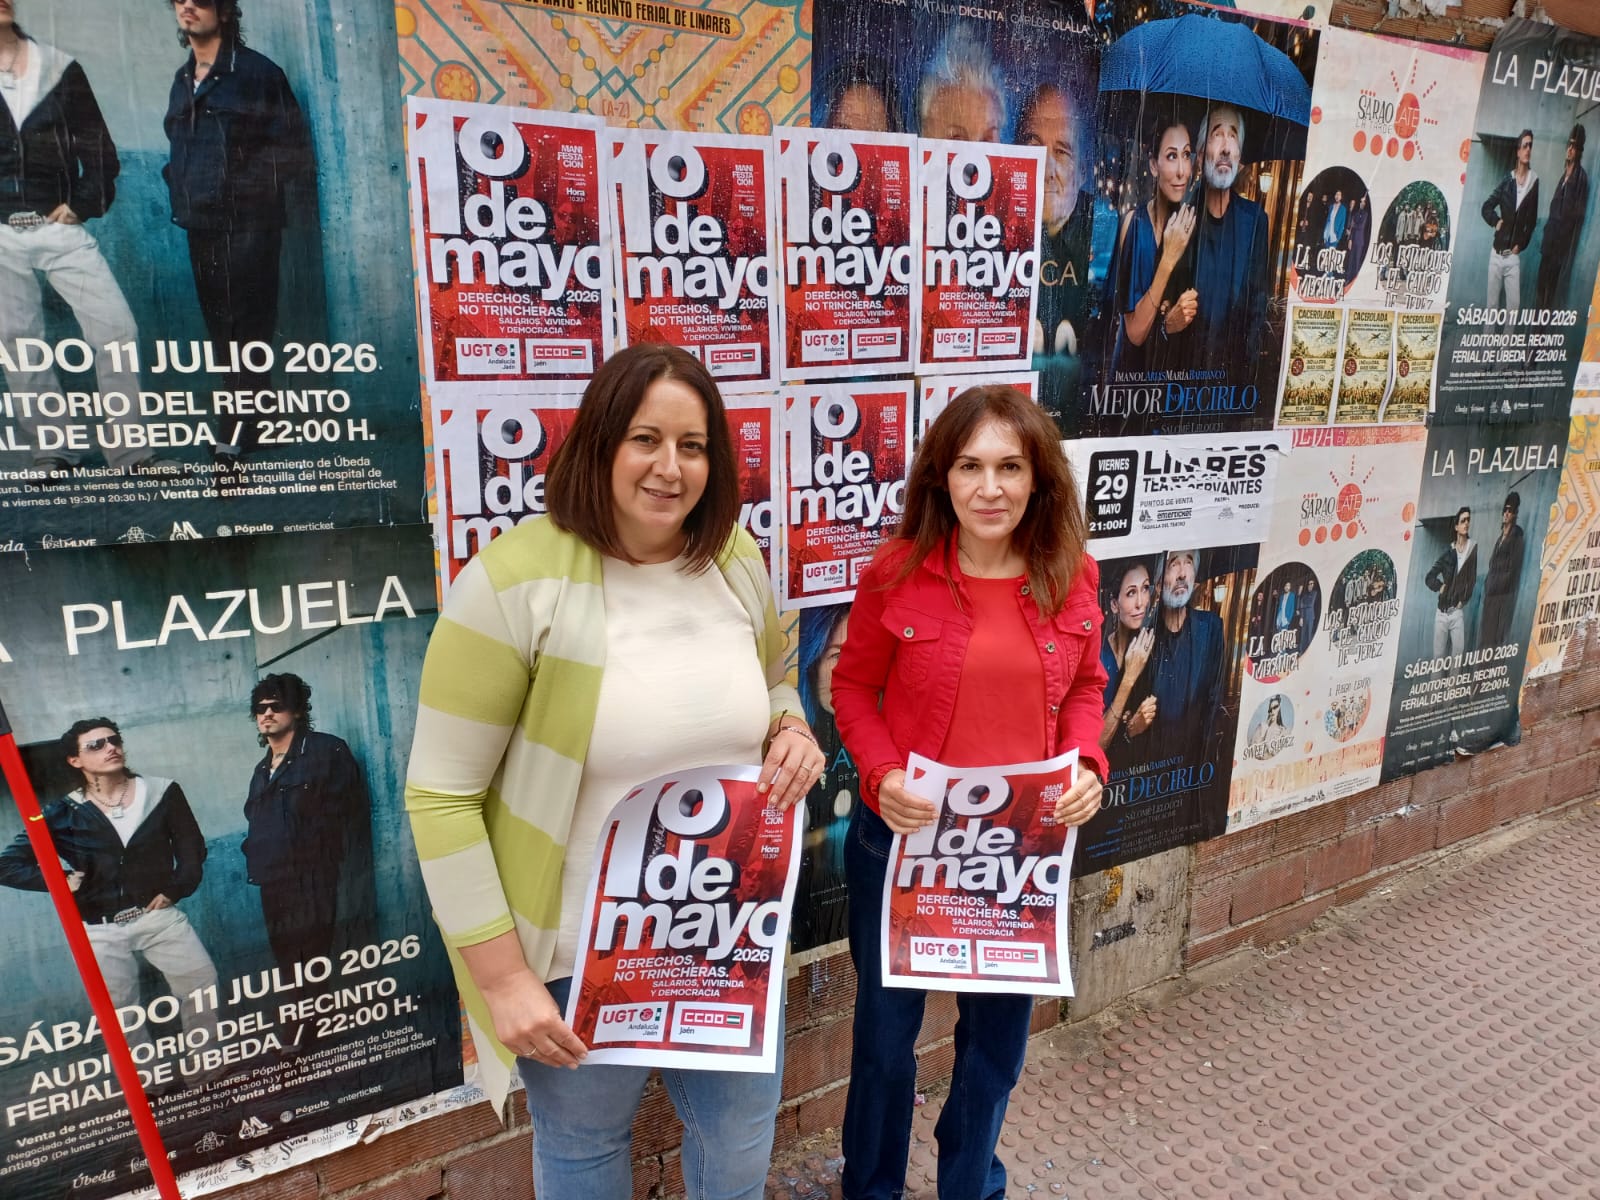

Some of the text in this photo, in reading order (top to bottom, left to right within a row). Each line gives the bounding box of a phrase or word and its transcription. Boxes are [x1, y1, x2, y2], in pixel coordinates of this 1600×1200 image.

[586, 0, 731, 34] RECINTO FERIAL DE LINARES
[959, 5, 1004, 21] DICENTA
[1052, 17, 1088, 33] OLALLA
[1492, 50, 1518, 87] LA
[565, 187, 586, 197] Hora
[464, 181, 547, 240] de
[812, 195, 871, 244] de
[653, 201, 723, 255] de
[429, 237, 601, 301] mayo
[786, 245, 911, 296] mayo
[925, 248, 1035, 298] mayo
[626, 255, 769, 310] mayo
[884, 285, 909, 296] 2026
[458, 292, 534, 306] DERECHOS,
[566, 290, 600, 303] 2026
[738, 298, 767, 310] 2026
[805, 291, 860, 301] DERECHOS,
[939, 292, 987, 301] DERECHOS,
[458, 304, 567, 317] NO TRINCHERAS.
[650, 304, 712, 315] DERECHOS,
[822, 300, 884, 310] TRINCHERAS.
[544, 318, 582, 326] VIVIENDA
[650, 314, 740, 326] NO TRINCHERAS.
[1298, 309, 1335, 320] CACEROLADA
[1353, 311, 1388, 322] CACEROLADA
[1457, 304, 1578, 326] SÁBADO JULIO 2026
[507, 326, 564, 335] DEMOCRACIA
[937, 332, 957, 344] UGT
[1460, 334, 1565, 347] AUDITORIO RECINTO
[104, 340, 140, 373] 11
[151, 340, 275, 374] JULIO
[283, 342, 378, 374] 2026
[460, 343, 493, 357] UGT
[535, 347, 569, 358] CCOO
[1451, 347, 1558, 363] FERIAL ÚBEDA 22:00
[0, 389, 351, 418] ITORIO DEL RECINTO
[1087, 382, 1260, 418] MEJOR DECIRLO
[37, 417, 377, 450] DE ÚBEDA 22:00 H.
[73, 465, 125, 479] Musical
[129, 463, 181, 478] Linares,
[184, 461, 230, 475] Pópulo,
[232, 459, 314, 474] Ayuntamiento
[334, 455, 371, 468] Úbeda
[814, 441, 870, 486] de
[1098, 457, 1130, 472] VIERNES
[1431, 444, 1558, 477] LA PLAZUELA
[136, 468, 365, 488] 9:00 13:00 taquilla Hospital
[160, 480, 398, 500] Venta entradas online Enterticket
[1094, 474, 1129, 501] 29
[1098, 502, 1121, 515] MAYO
[234, 522, 334, 533] Pópulo enterticket
[806, 524, 858, 538] DERECHOS,
[1089, 519, 1128, 532] 21:00H
[822, 530, 880, 544] TRINCHERAS.
[62, 575, 416, 655] PLAZUELA
[1538, 603, 1559, 625] LORI
[1538, 624, 1560, 646] NIÑA
[1404, 643, 1519, 679] SÁBADO 2026
[1409, 665, 1508, 696] AUDITORIO RECINTO
[1443, 684, 1471, 702] ÚBEDA
[1128, 761, 1215, 803] DECIRLO
[937, 818, 1016, 855] de
[645, 840, 733, 901] de
[897, 854, 1063, 904] mayo
[917, 894, 988, 908] DERECHOS,
[1021, 894, 1055, 907] 2026
[916, 905, 1020, 920] NO TRINCHERAS.
[593, 900, 784, 961] mayo
[952, 918, 1035, 929] SALARIOS, VIVIENDA
[959, 927, 1015, 937] DEMOCRACIA
[732, 949, 771, 962] 2026
[914, 942, 945, 956] UGT
[986, 950, 1021, 960] CCOO
[616, 954, 696, 970] DERECHOS,
[189, 984, 219, 1014] 11
[228, 956, 332, 1006] JULIO
[339, 934, 421, 976] 2026
[613, 966, 729, 982] NO TRINCHERAS.
[652, 979, 745, 988] SALARIOS, VIVIENDA
[658, 988, 721, 997] DEMOCRACIA
[602, 1008, 638, 1024] UGT
[684, 1012, 724, 1025] CCOO
[30, 976, 397, 1096] AUDIORIO DEL RECINTO
[6, 1080, 125, 1128] FERIAL
[179, 1032, 282, 1077] ÚBEDA
[316, 1002, 388, 1038] 22:00
[394, 994, 419, 1017] H.
[231, 1089, 265, 1104] Venta
[335, 1058, 367, 1074] online
[384, 1038, 437, 1059] Enterticket
[16, 1025, 414, 1148] Venta entrada Musical Pópulo, Ayuntamiento Úbeda
[6, 1053, 349, 1163] (Negociado Cultura. taquilla
[72, 1084, 383, 1189] Úbeda Pópulo enterticket
